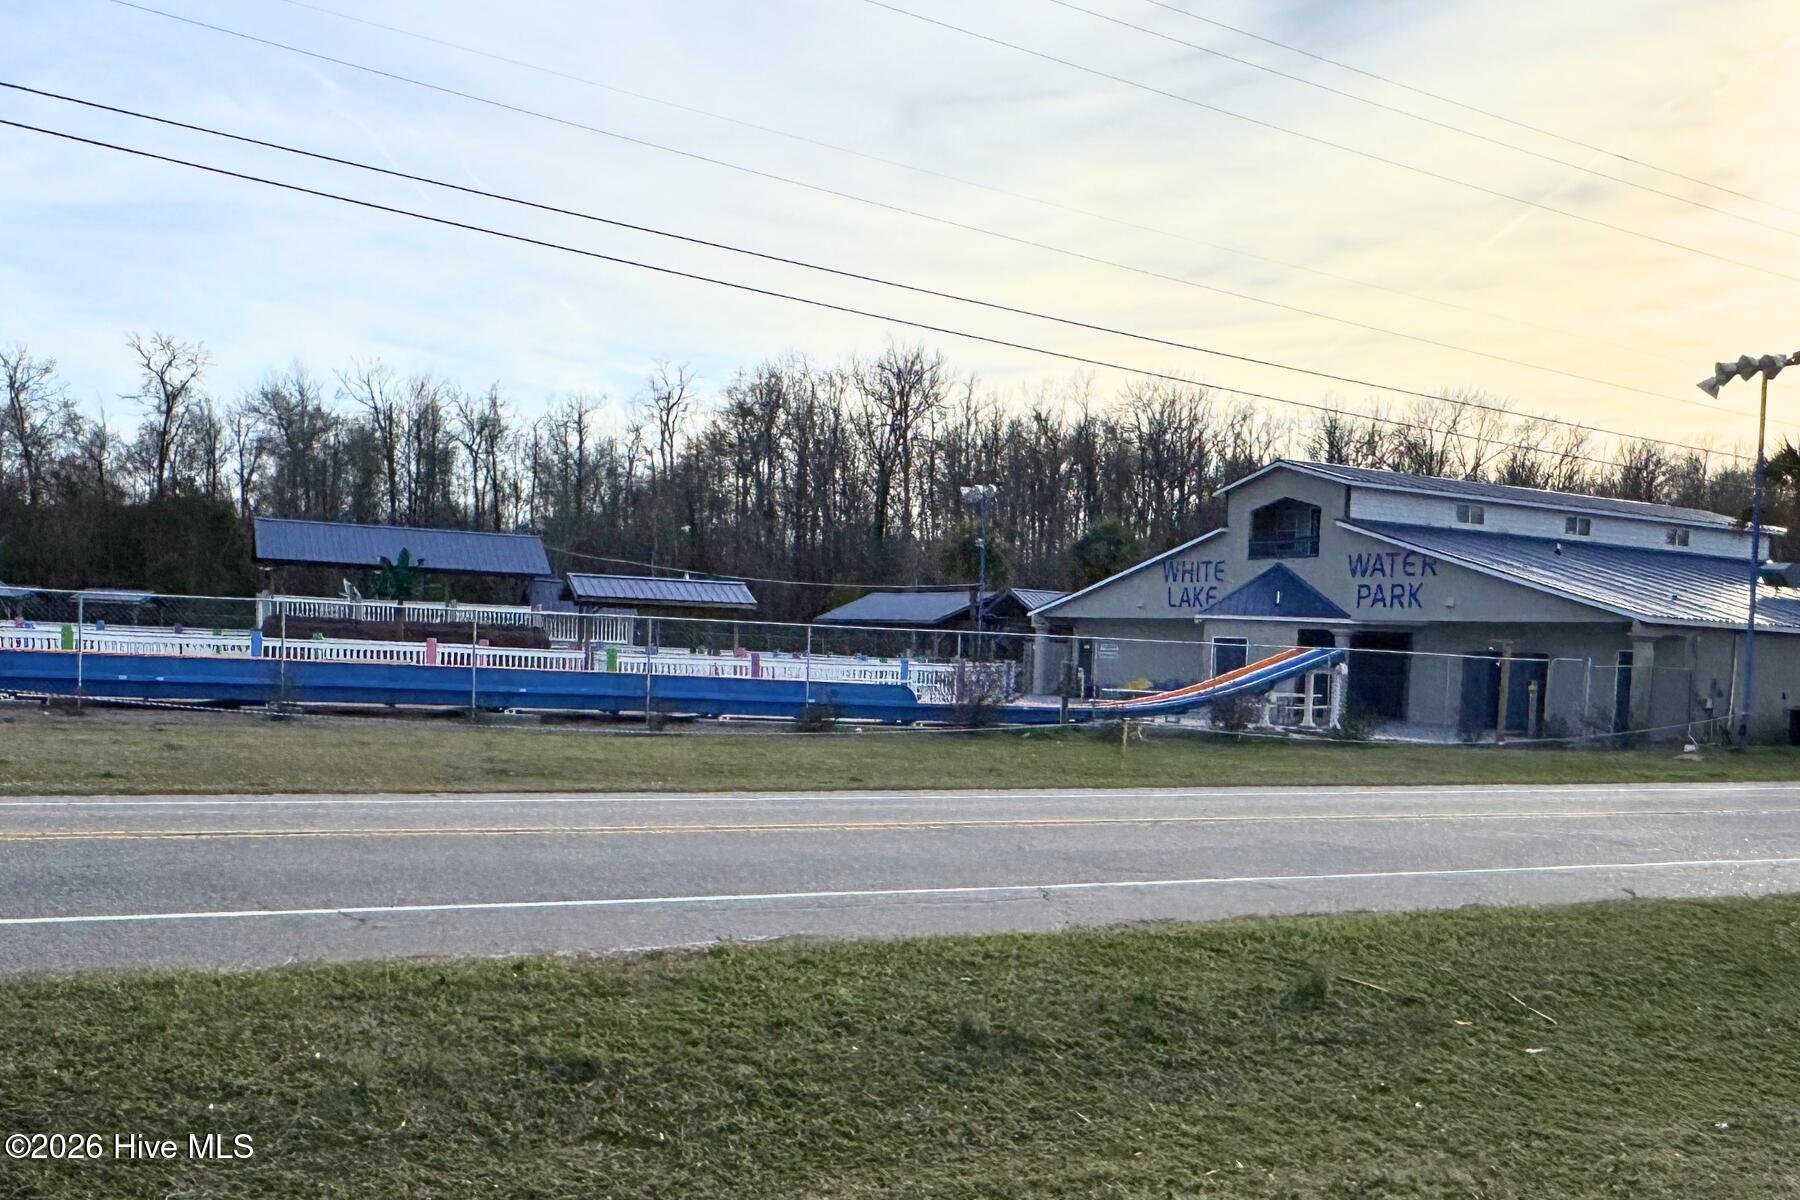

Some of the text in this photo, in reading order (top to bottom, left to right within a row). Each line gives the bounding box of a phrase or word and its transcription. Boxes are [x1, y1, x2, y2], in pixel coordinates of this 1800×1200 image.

[1163, 560, 1225, 583] WHITE
[1348, 550, 1438, 578] WATER
[1168, 586, 1217, 608] LAKE
[1356, 582, 1423, 609] PARK
